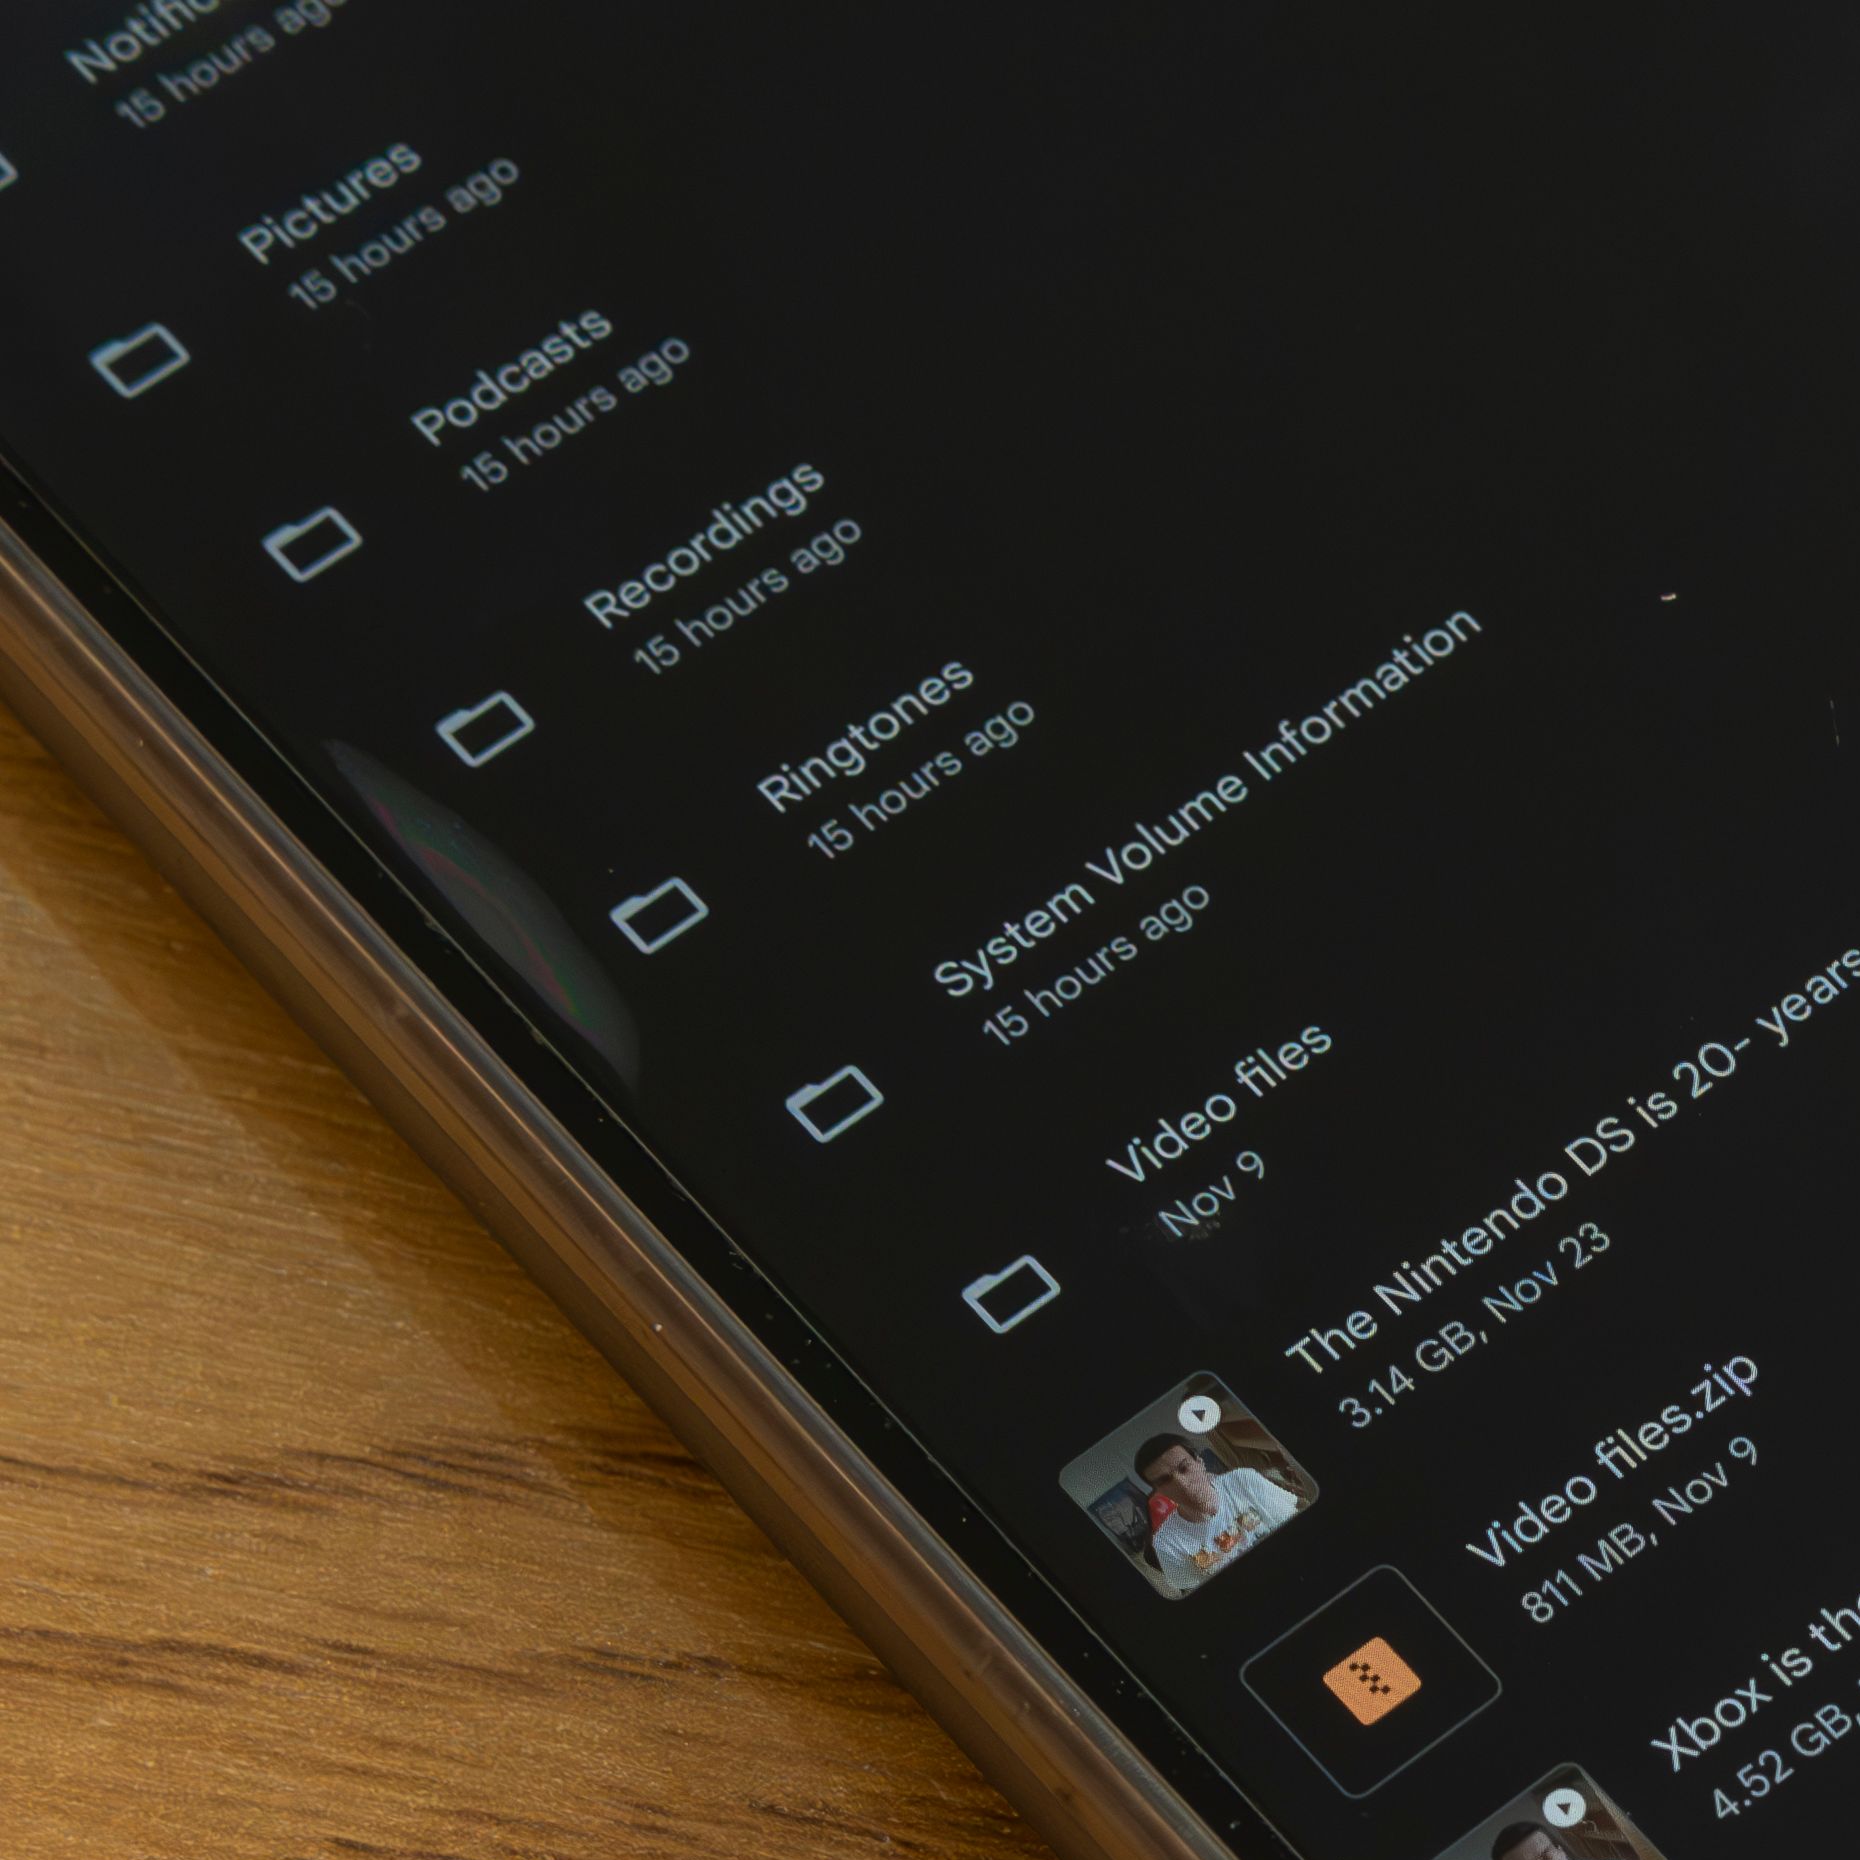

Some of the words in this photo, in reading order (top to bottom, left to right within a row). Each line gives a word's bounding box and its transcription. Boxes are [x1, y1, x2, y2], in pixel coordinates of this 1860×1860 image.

[114, 87, 166, 128] 15
[157, 26, 276, 102] hours
[273, 0, 346, 34] ag
[238, 143, 421, 264] Pictures
[289, 269, 336, 308] 15
[329, 206, 446, 283] hours
[446, 159, 518, 213] ago
[410, 310, 612, 446] Podcasts
[460, 451, 508, 491] 15
[501, 386, 617, 464] hours
[617, 338, 689, 393] ago
[583, 463, 824, 629] Recordings
[633, 634, 680, 674] 15
[674, 567, 789, 647] hours
[790, 519, 861, 573] ago
[756, 661, 973, 813] Ringtones
[807, 818, 853, 858] 15
[847, 751, 962, 831] hours
[964, 701, 1034, 756] ago
[933, 883, 1095, 997] System
[1084, 774, 1248, 884] Volume
[1242, 610, 1482, 780] Information
[982, 1004, 1029, 1045] 15
[1023, 936, 1138, 1017] hours
[1139, 884, 1209, 941] ago
[1104, 1093, 1237, 1182] Video
[1234, 1025, 1331, 1097] files
[1158, 1175, 1235, 1236] Nov
[1236, 1150, 1264, 1179] 9
[1283, 1310, 1377, 1373] The
[1372, 1171, 1568, 1316] Nintendo
[1563, 1116, 1635, 1176] DS
[1626, 1091, 1678, 1128] is
[1338, 1364, 1415, 1428] 3.14
[1414, 1320, 1488, 1372] GB,
[1481, 1260, 1558, 1323] Nov
[1557, 1221, 1610, 1269] 23
[1465, 1475, 1597, 1567] Video
[1593, 1355, 1758, 1479] files.zip
[1520, 1568, 1582, 1623] 811
[1575, 1522, 1658, 1581] MB,
[1651, 1461, 1728, 1525] Nov
[1728, 1436, 1757, 1466] 9
[1650, 1676, 1773, 1773] Xbox
[1760, 1647, 1813, 1686] is
[1713, 1749, 1794, 1819] 4.52
